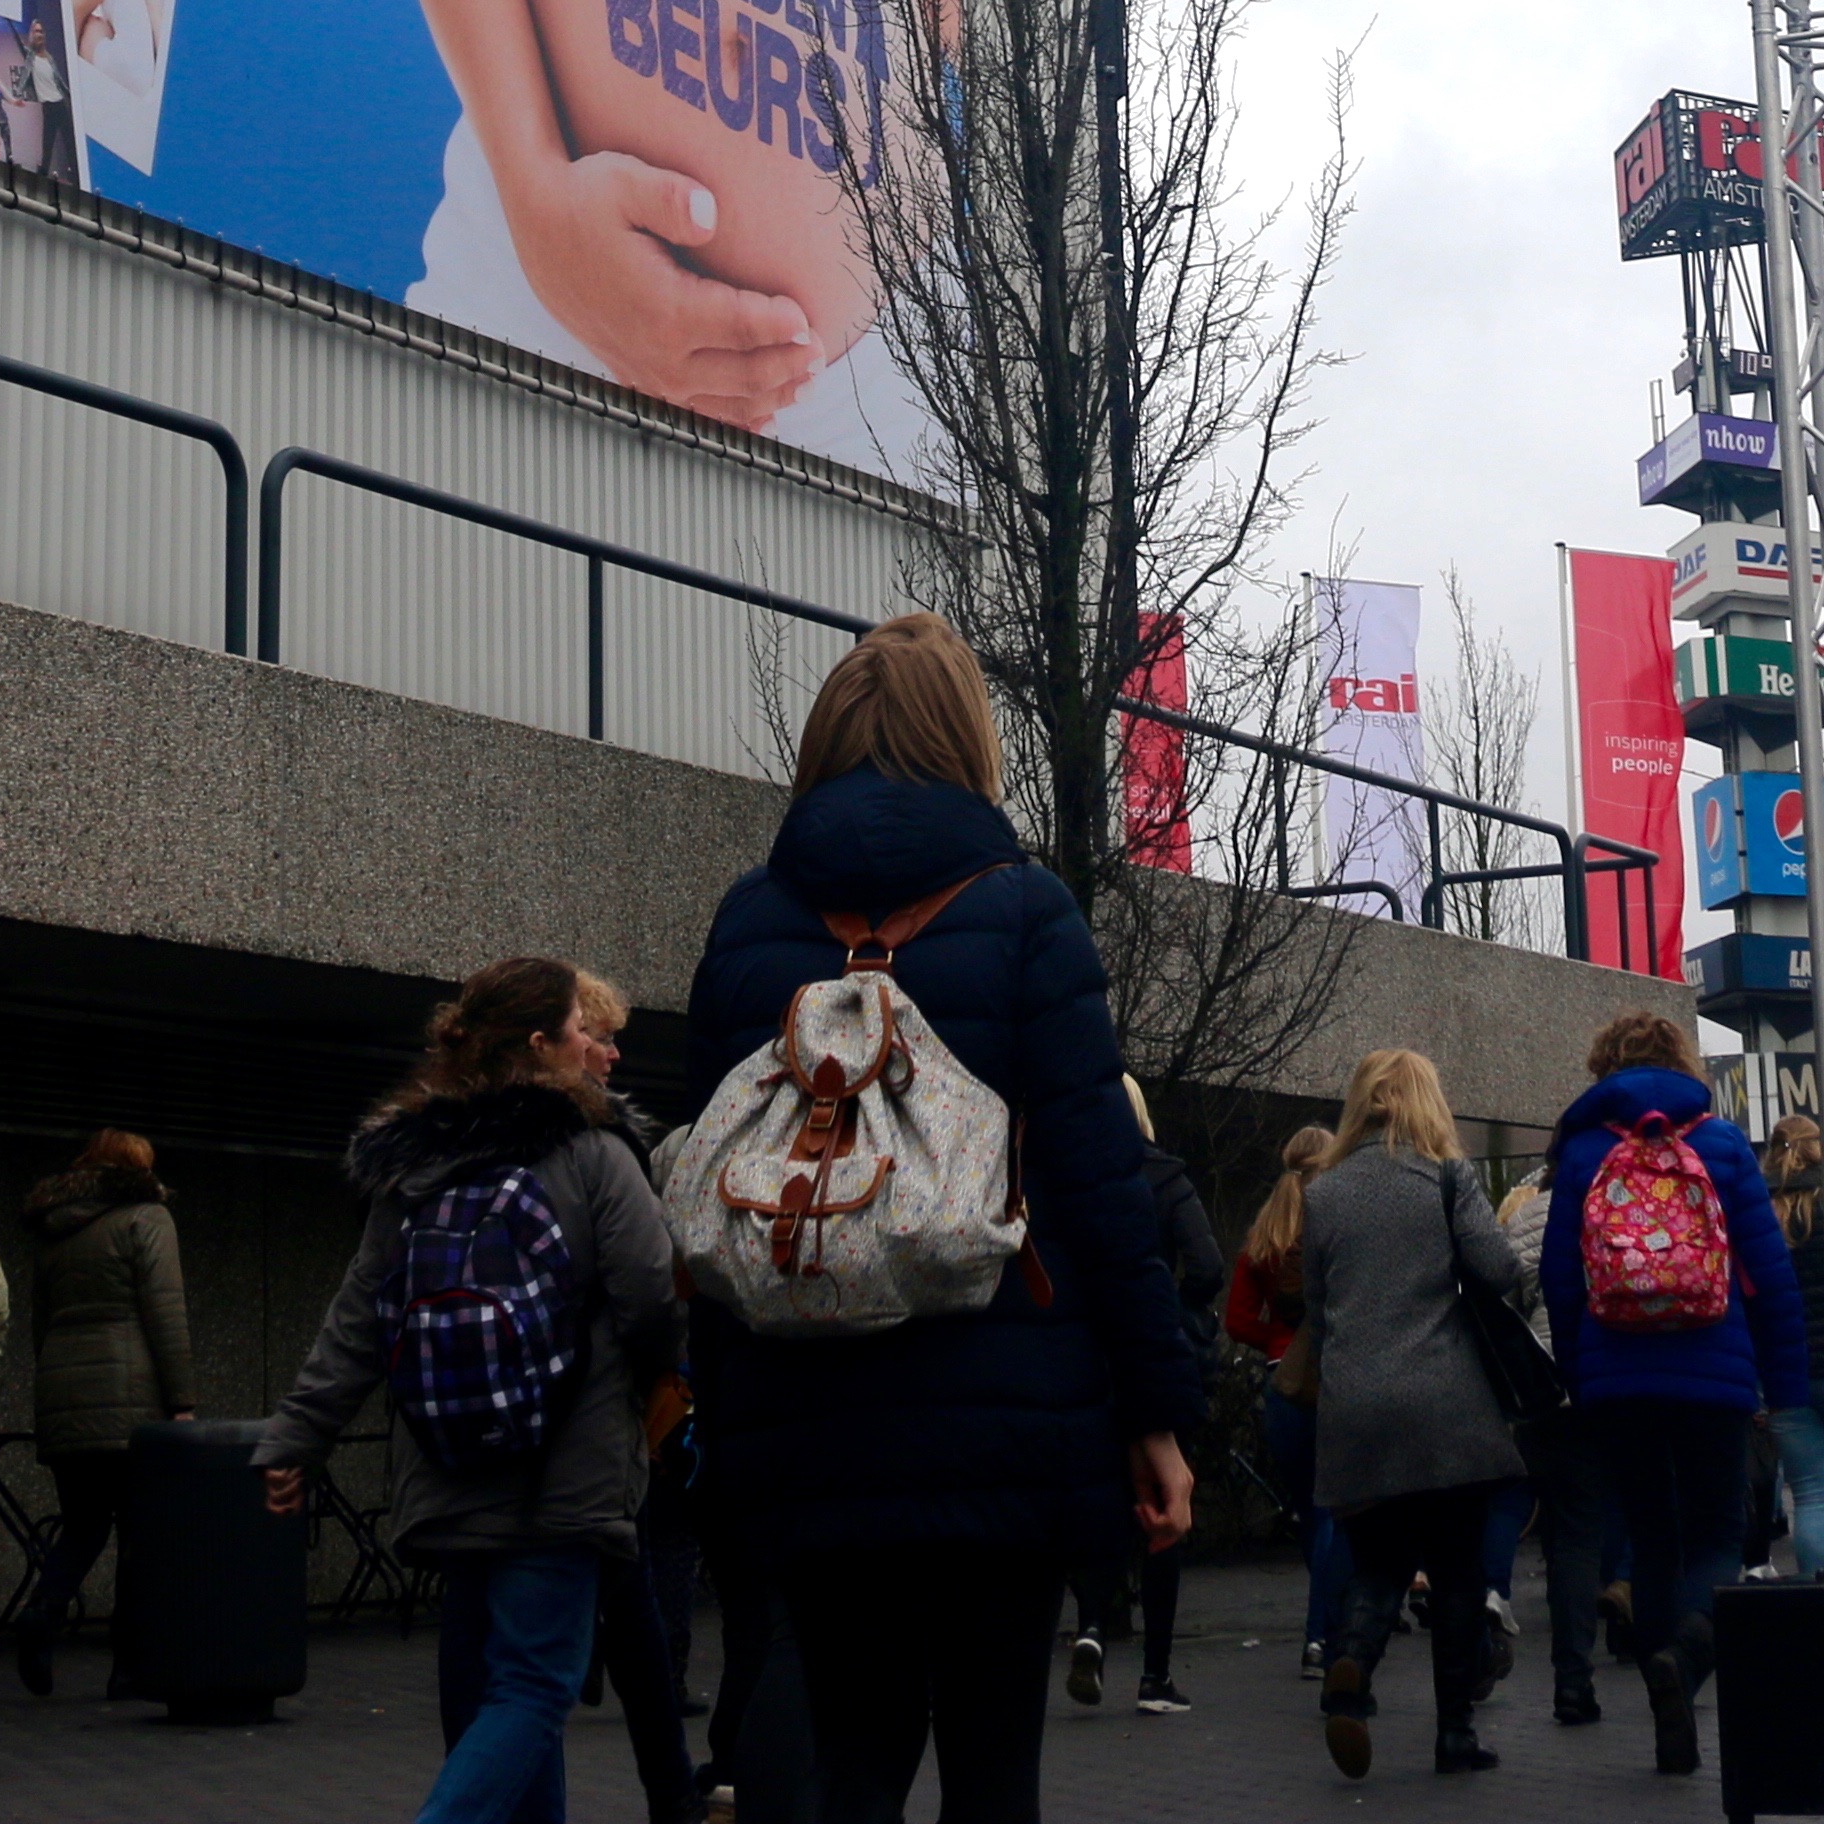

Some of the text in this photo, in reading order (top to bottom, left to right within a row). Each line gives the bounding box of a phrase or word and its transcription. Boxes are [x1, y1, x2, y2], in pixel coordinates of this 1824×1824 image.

[1617, 99, 1666, 216] rai
[1705, 425, 1766, 455] nhow
[1329, 673, 1418, 714] rai
[1605, 731, 1679, 758] inspiring
[1612, 757, 1674, 777] people
